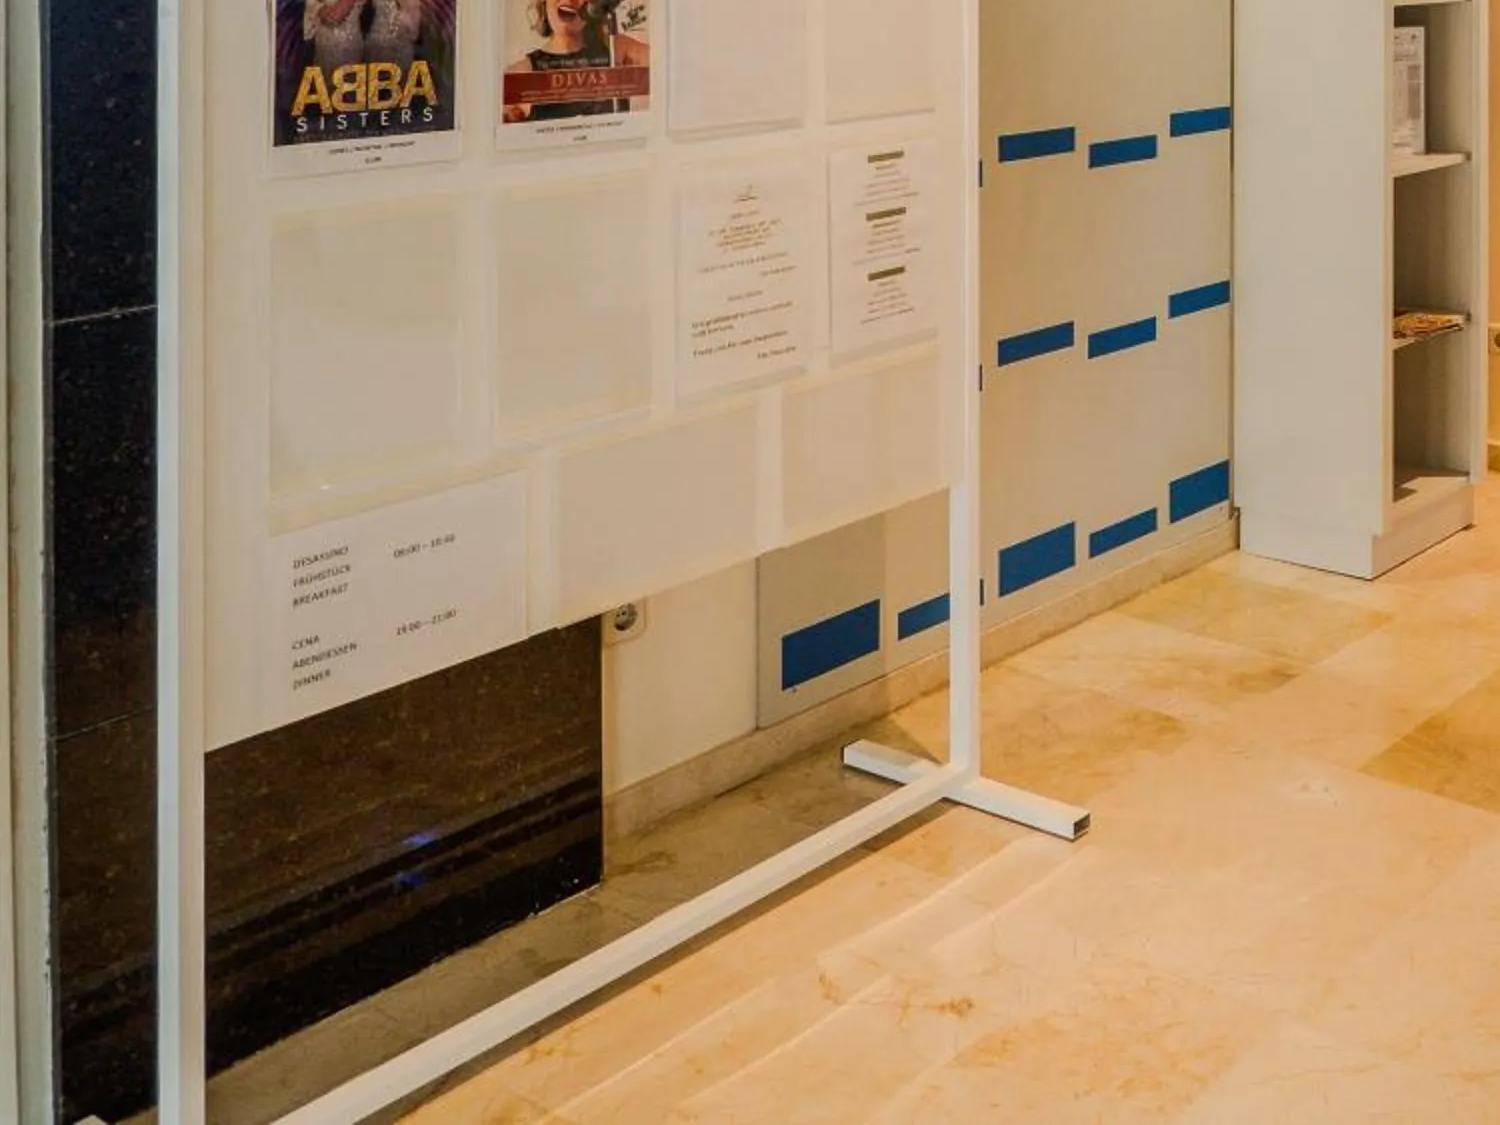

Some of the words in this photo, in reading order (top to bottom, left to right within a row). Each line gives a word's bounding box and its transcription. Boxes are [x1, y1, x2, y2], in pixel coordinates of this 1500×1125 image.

[291, 60, 438, 116] ABBA
[551, 71, 607, 88] DIVAS
[296, 106, 433, 133] SISTERS
